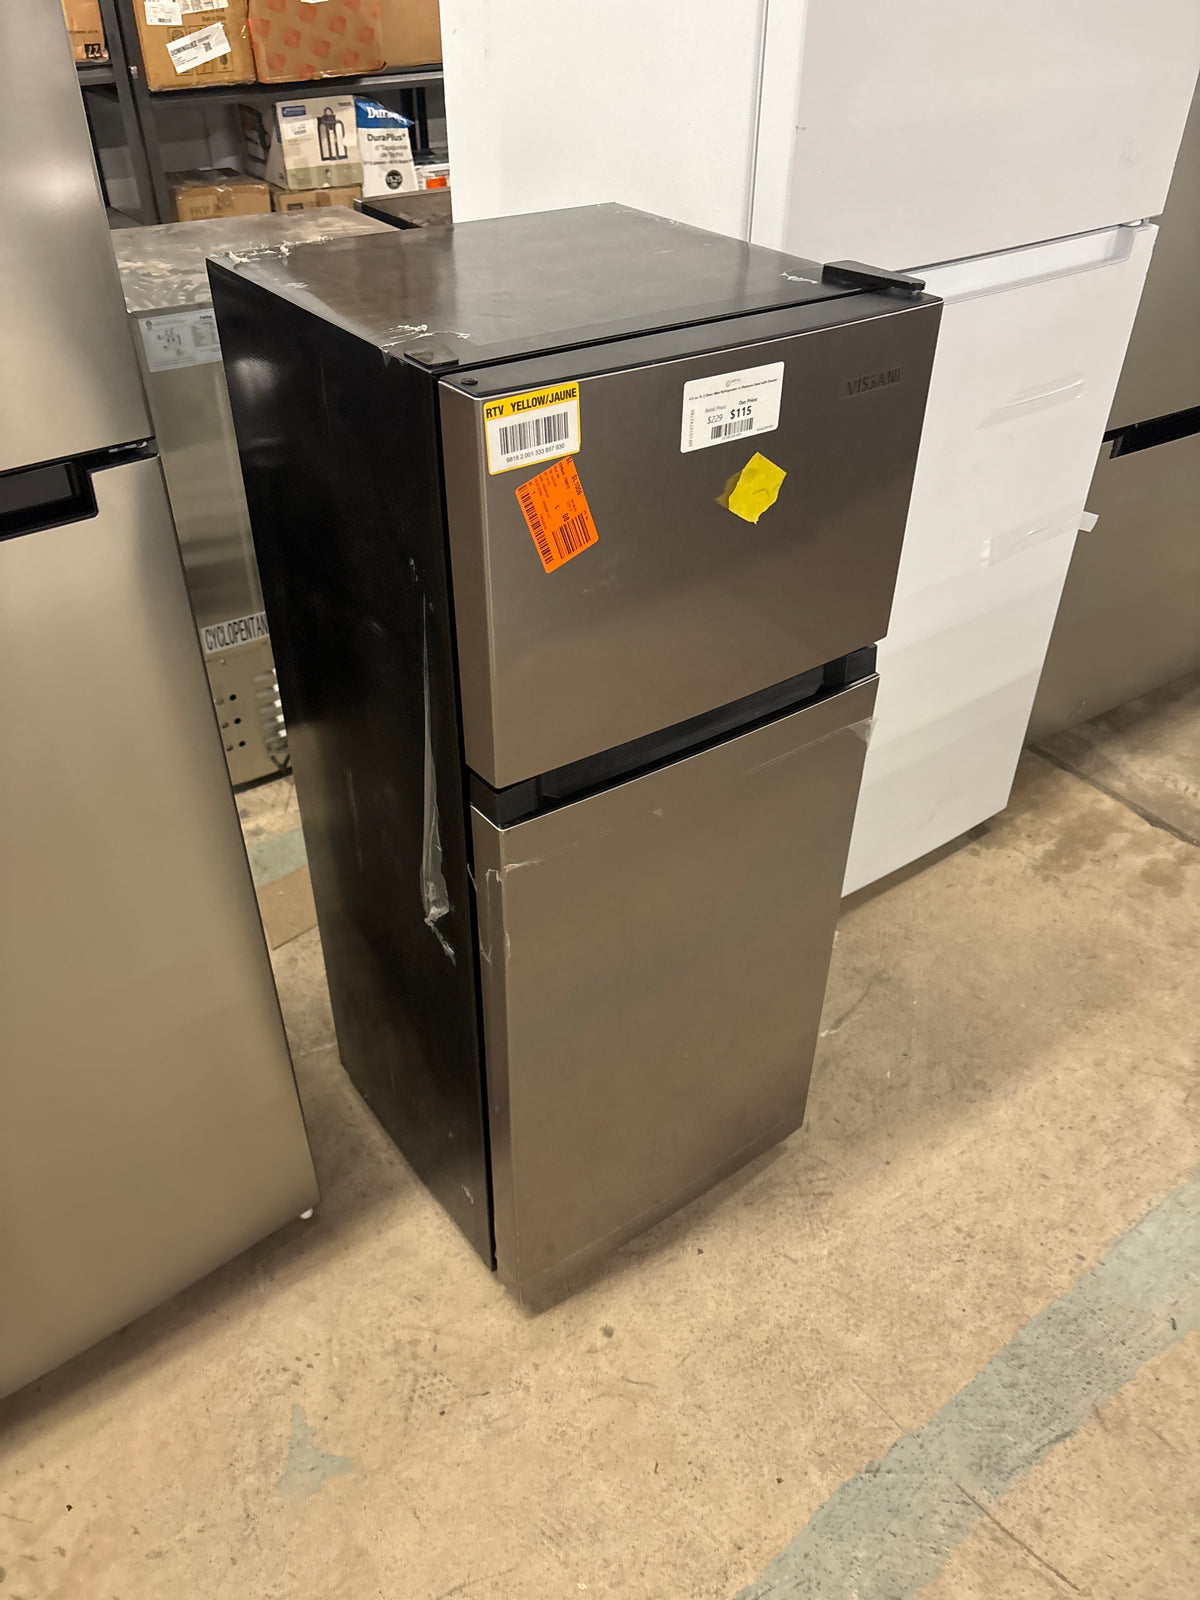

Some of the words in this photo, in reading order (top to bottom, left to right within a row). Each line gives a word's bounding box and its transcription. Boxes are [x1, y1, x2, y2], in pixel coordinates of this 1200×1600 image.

[847, 367, 901, 395] VISSANI
[485, 405, 505, 418] RTV
[510, 387, 577, 412] YELLOW/JAUNE
[706, 413, 723, 425] $229
[730, 405, 752, 420] $115
[534, 448, 545, 456] 333
